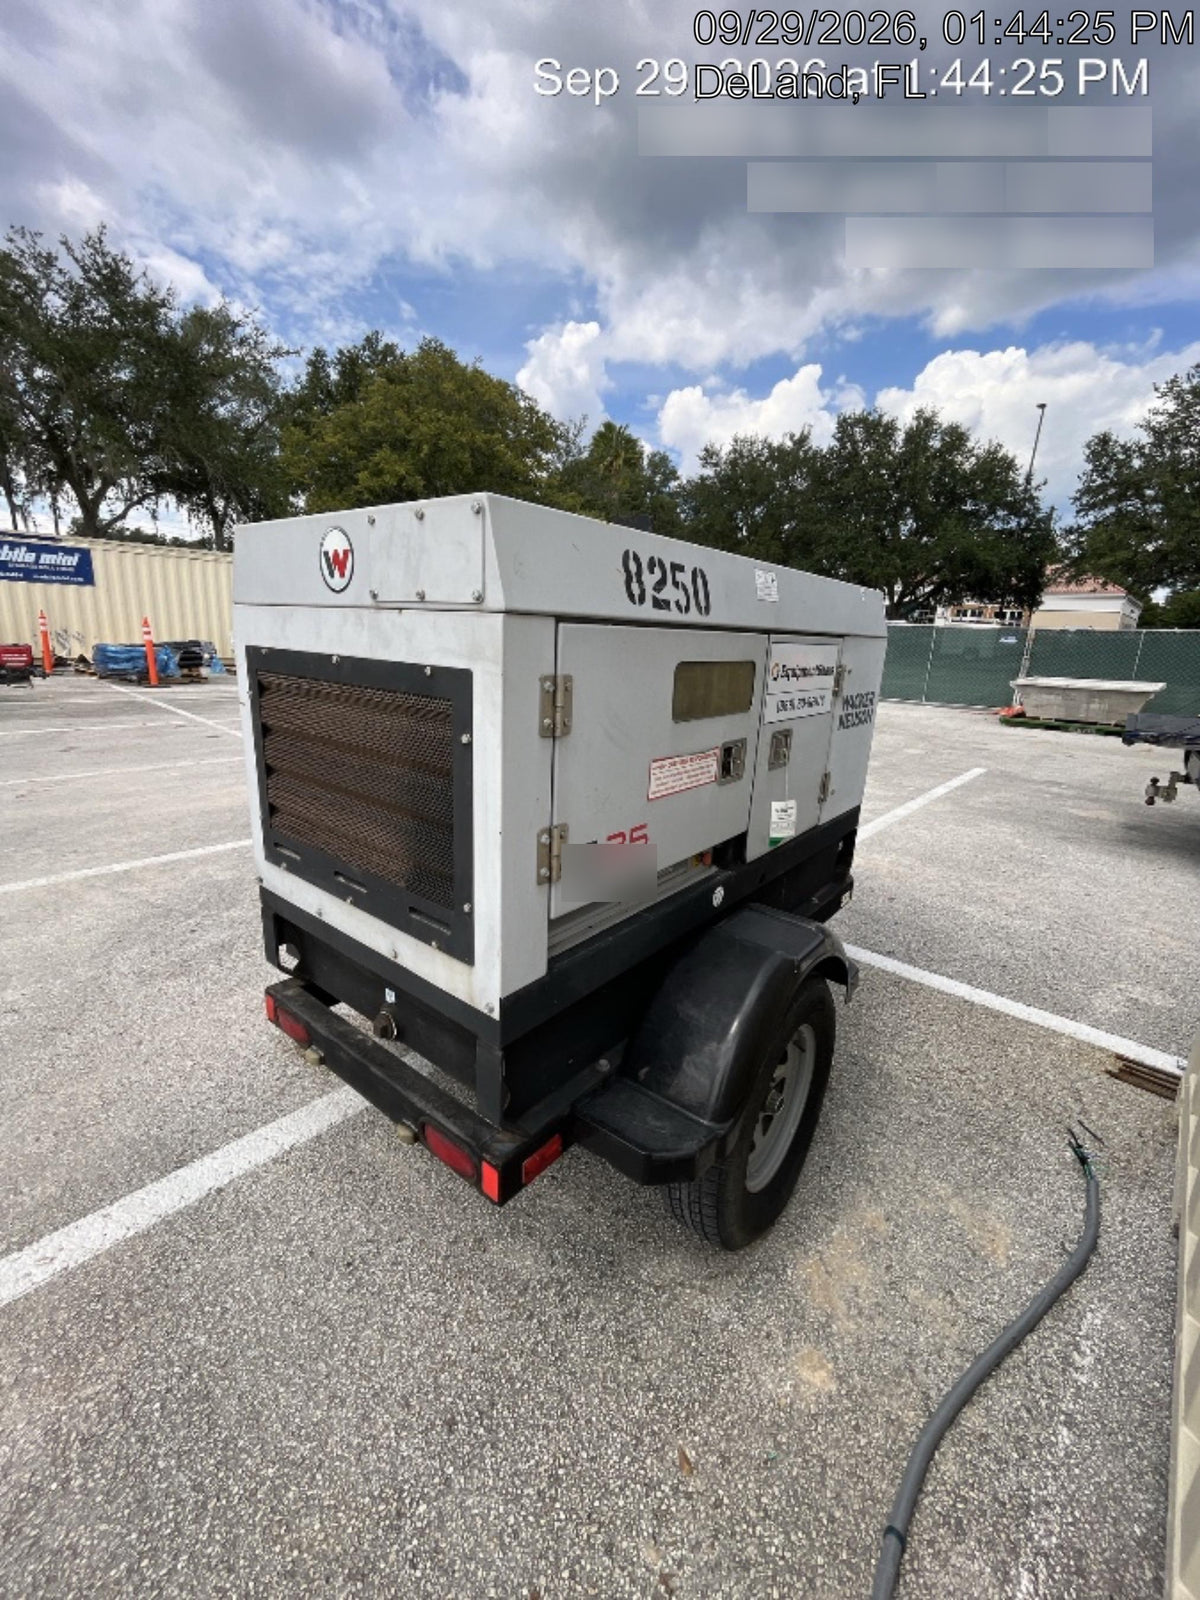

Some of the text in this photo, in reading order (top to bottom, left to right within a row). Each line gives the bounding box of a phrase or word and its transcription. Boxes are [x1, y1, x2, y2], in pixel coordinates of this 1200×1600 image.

[0, 545, 79, 567] bile mini
[622, 549, 711, 617] 8250
